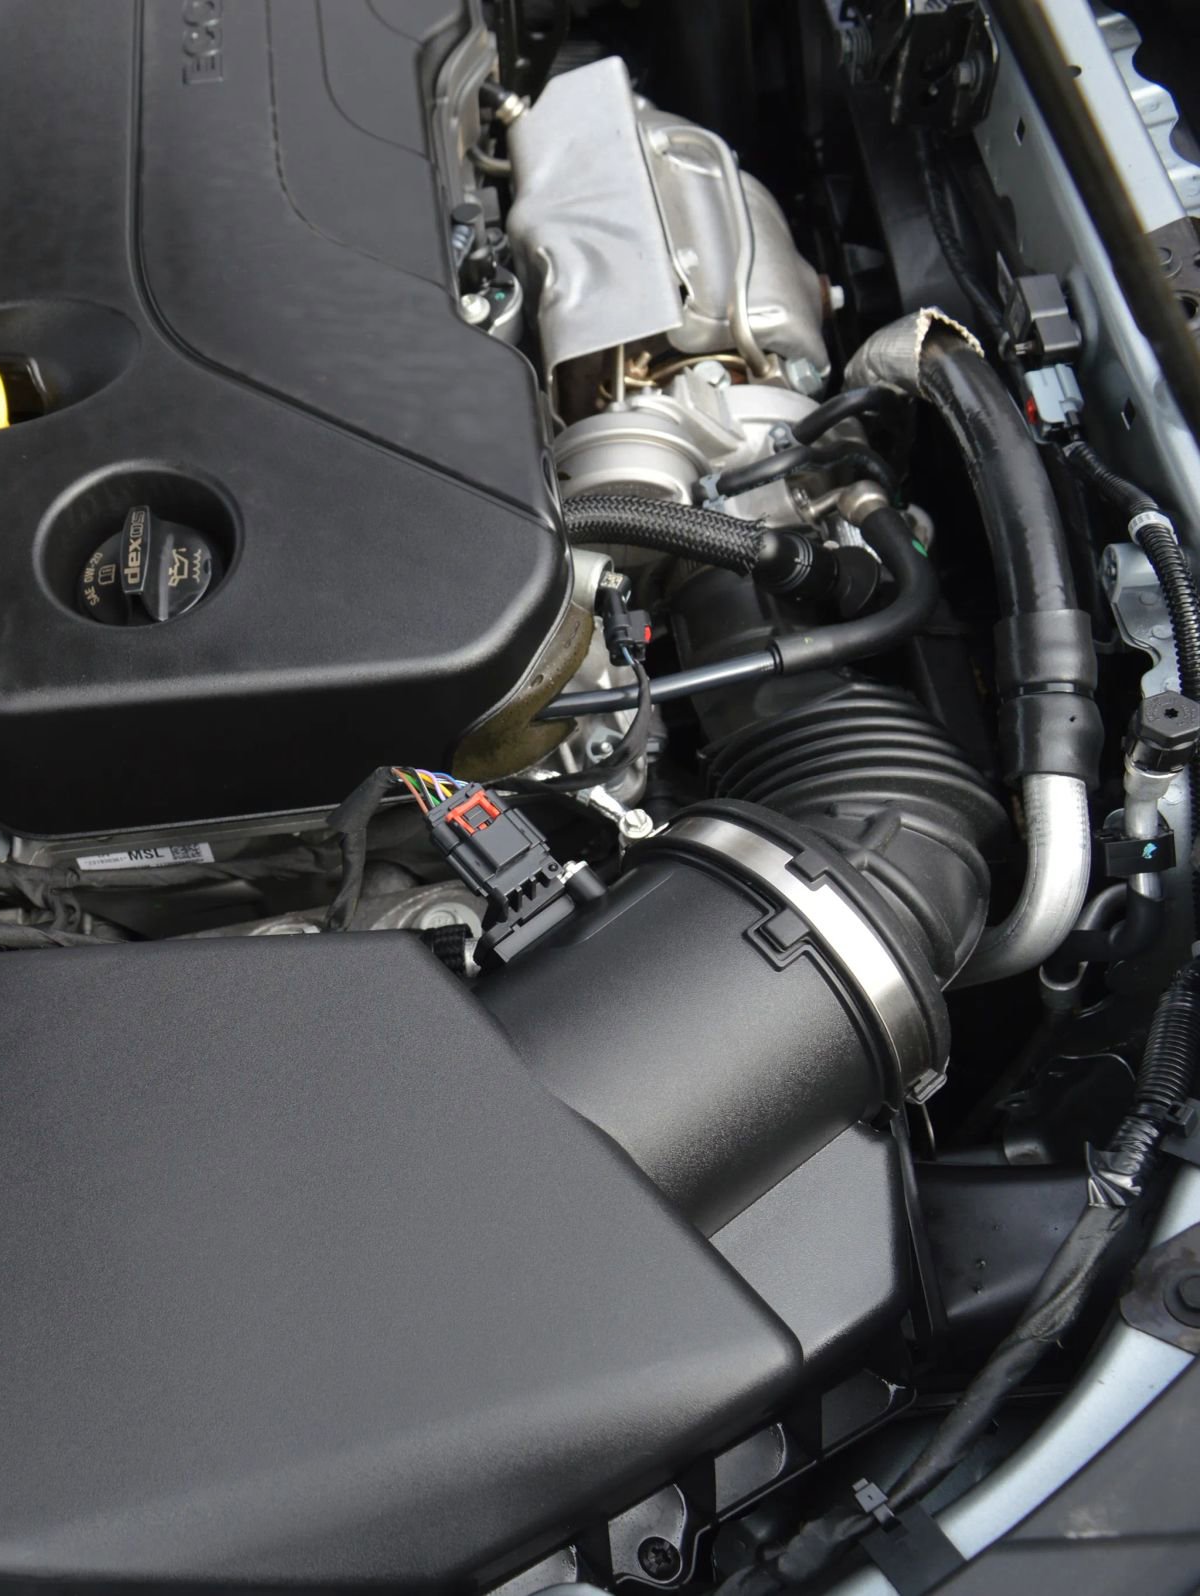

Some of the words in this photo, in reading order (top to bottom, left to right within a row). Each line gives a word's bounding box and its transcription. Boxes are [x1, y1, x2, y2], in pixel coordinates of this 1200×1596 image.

[124, 510, 145, 585] dexos
[84, 585, 100, 606] SAE
[128, 847, 164, 861] MSL
